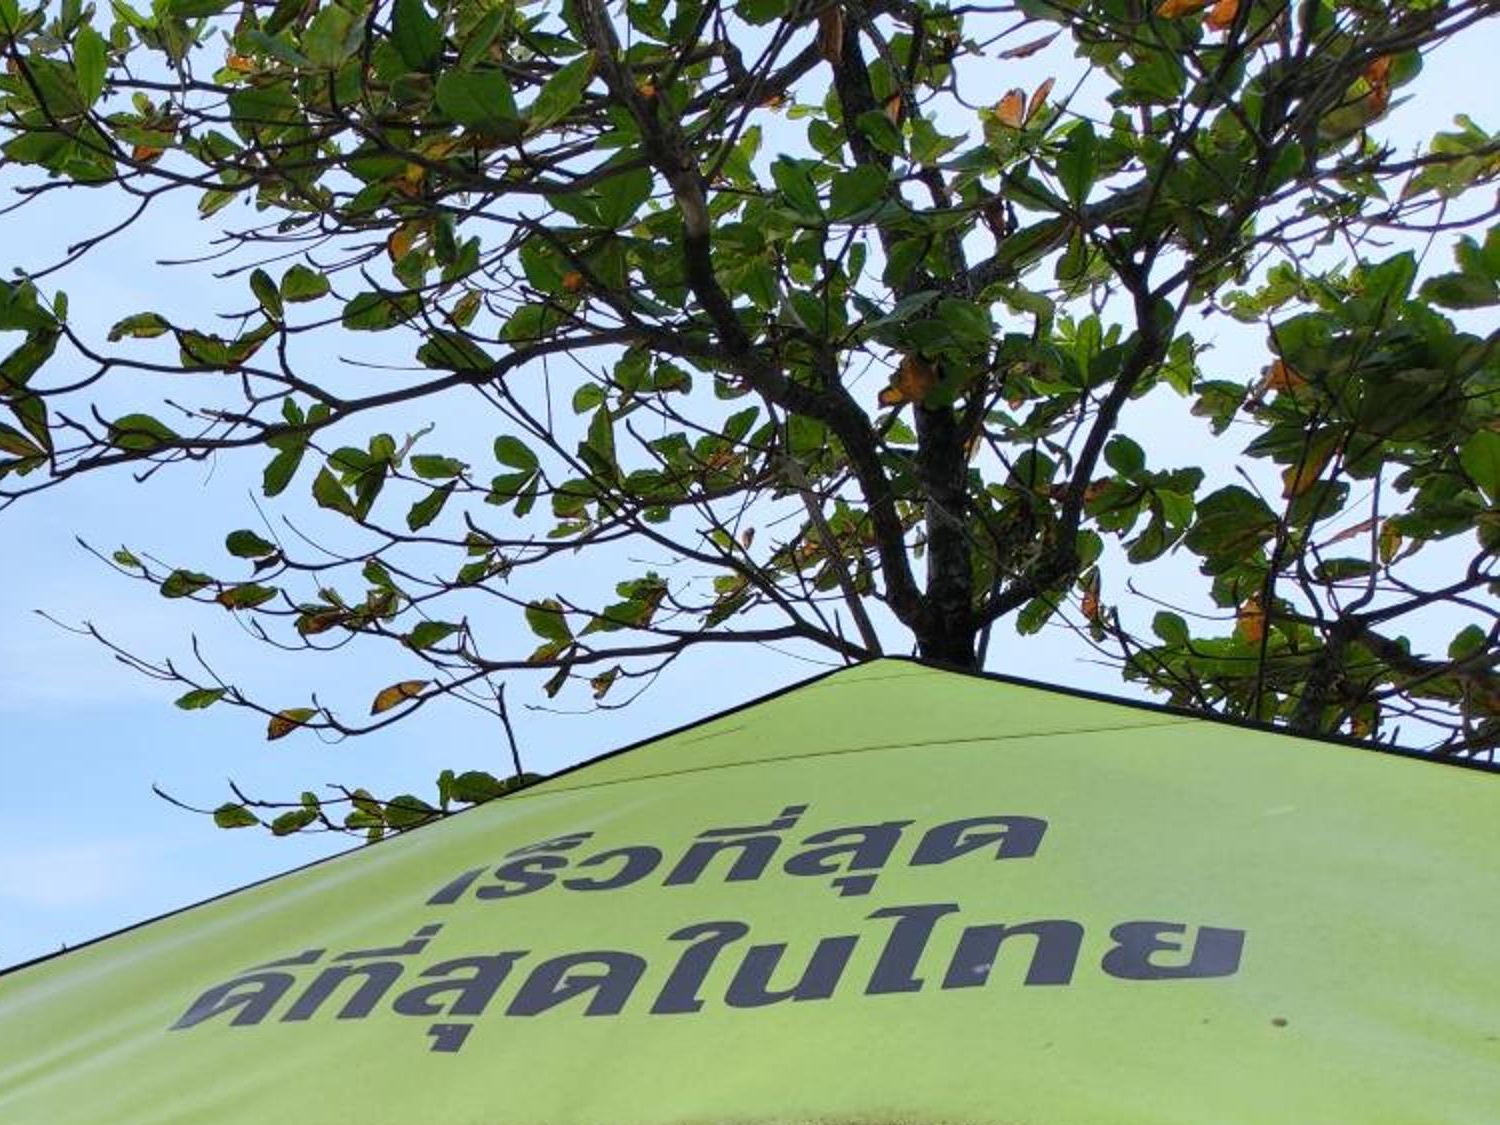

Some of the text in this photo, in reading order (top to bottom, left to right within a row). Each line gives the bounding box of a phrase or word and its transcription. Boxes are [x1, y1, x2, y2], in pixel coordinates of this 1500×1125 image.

[425, 804, 1049, 906] เร็วที่สุด
[167, 902, 1247, 1053] ดีที่สุดในไทย
